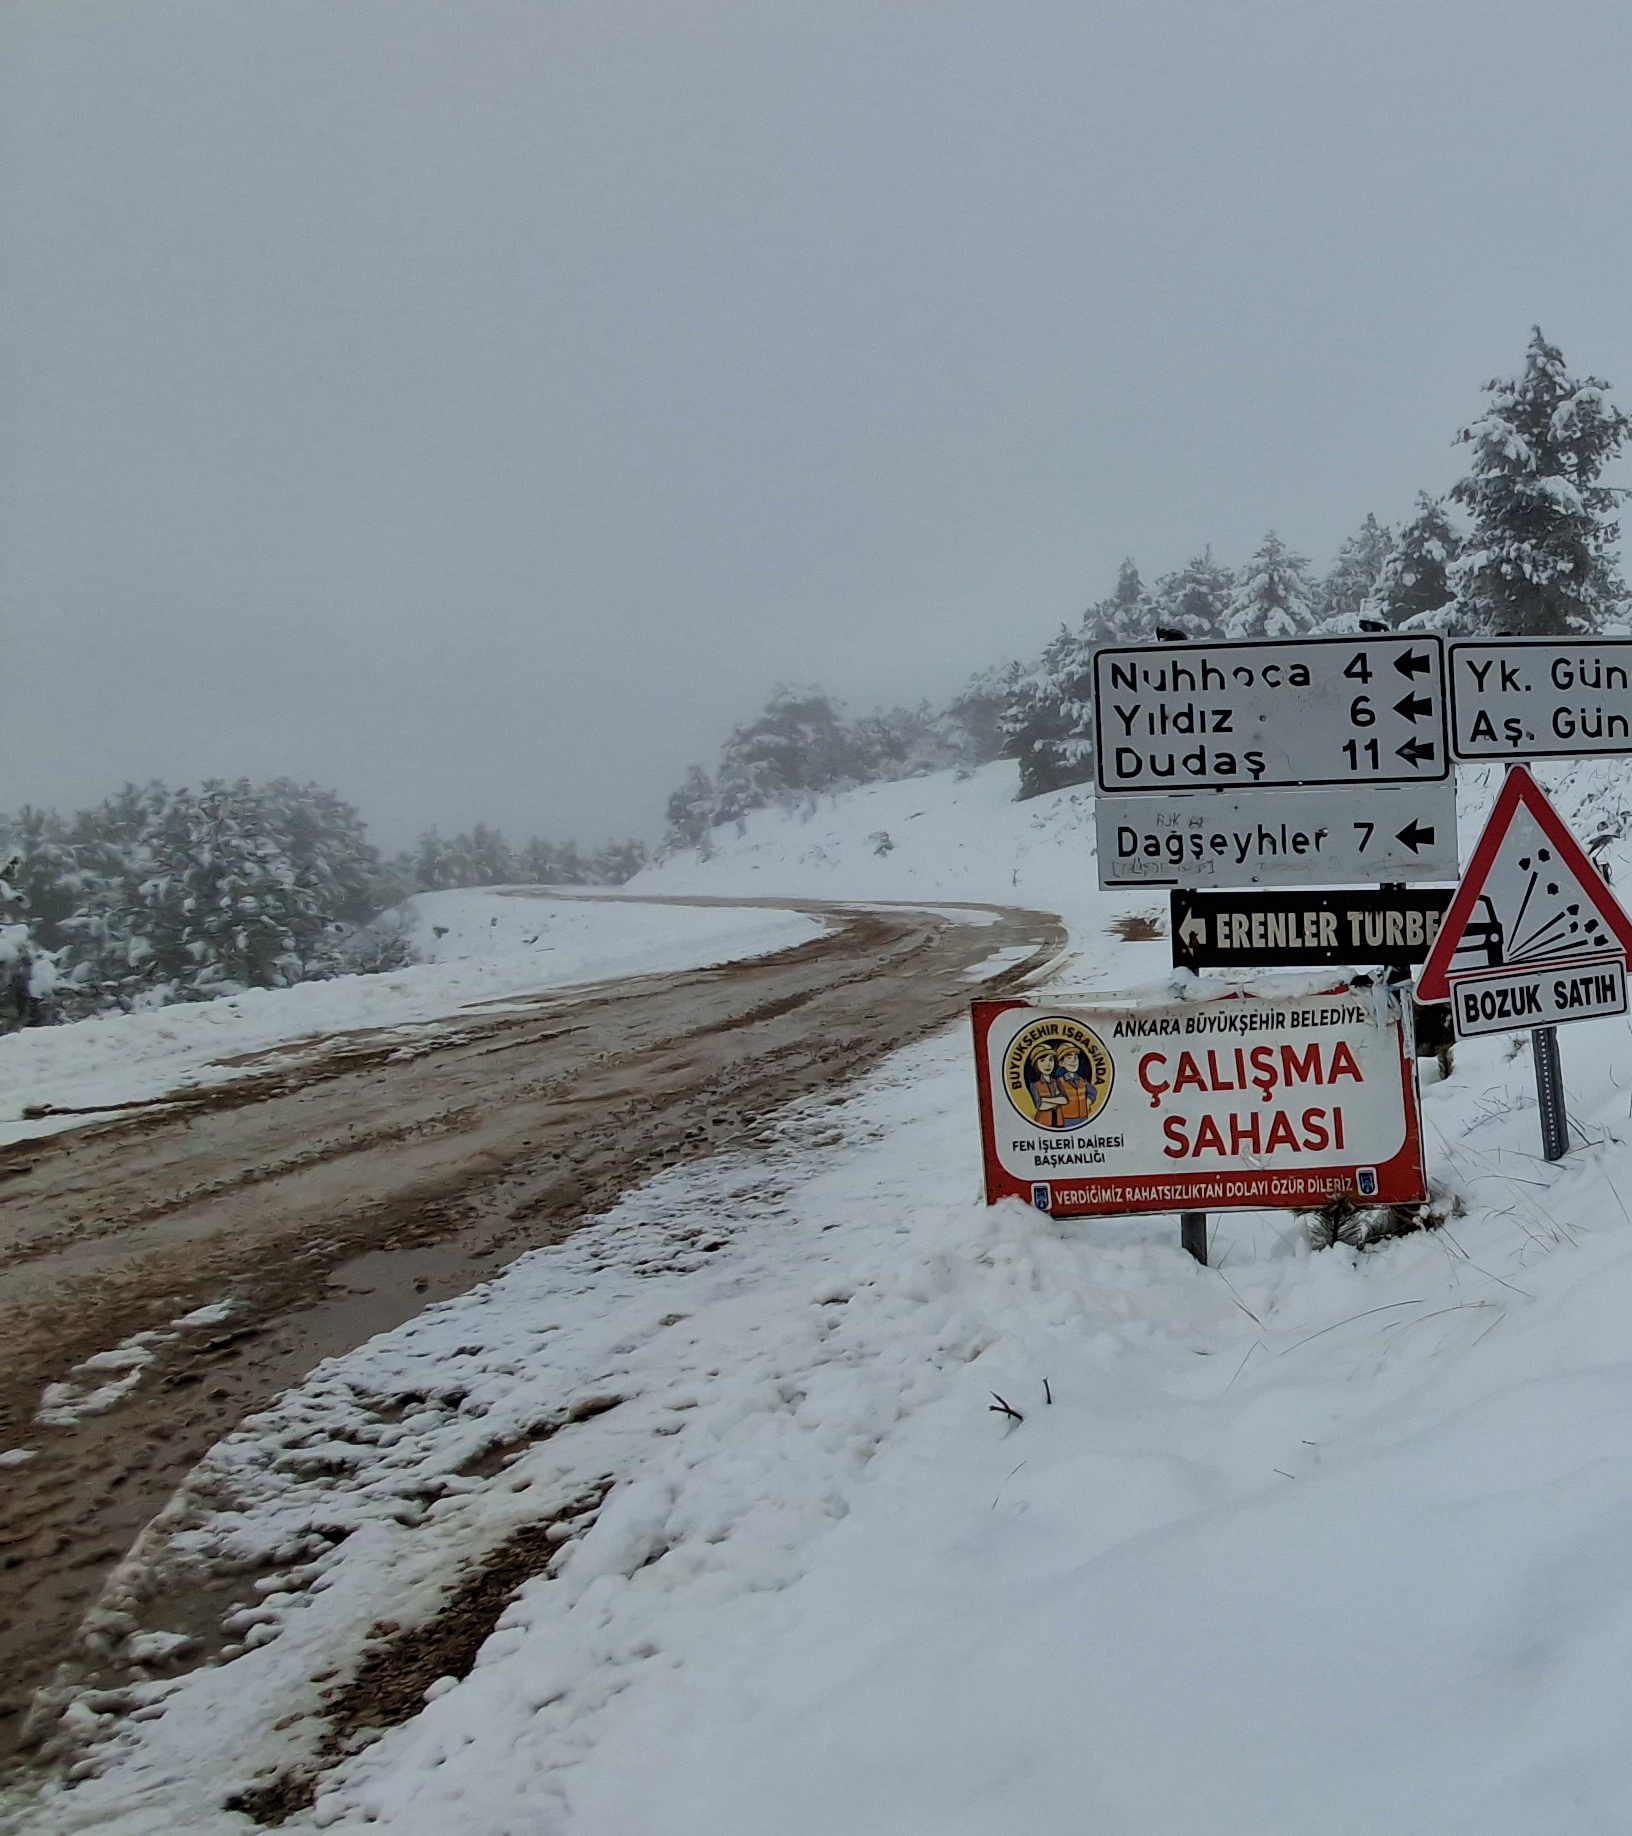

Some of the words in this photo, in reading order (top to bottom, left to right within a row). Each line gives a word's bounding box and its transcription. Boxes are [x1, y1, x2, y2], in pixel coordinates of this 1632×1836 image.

[1111, 659, 1311, 693] Nuhhoca
[1344, 653, 1373, 684] 4
[1466, 660, 1532, 693] Yk.
[1113, 703, 1234, 736] Yıldız
[1350, 696, 1376, 727] 6
[1470, 710, 1535, 747] Aş.
[1115, 745, 1266, 781] Dudaş
[1342, 738, 1380, 770] 11
[1117, 824, 1327, 864] Dağşeyhler
[1353, 822, 1375, 853] 7
[1216, 912, 1339, 949] ERENLER
[1464, 984, 1543, 1024] BOZUK
[1553, 973, 1617, 1009] SATIH
[1113, 1016, 1181, 1038] ANKARA
[1184, 1009, 1286, 1034] BÜYÜKŞEHİR
[1138, 1040, 1363, 1108] ÇALIŞMA
[1012, 1140, 1035, 1152] FEN
[1038, 1136, 1074, 1153] İŞLERİ
[1077, 1133, 1124, 1149] DAİRESİ
[1163, 1106, 1346, 1159] SAHASI
[1034, 1150, 1106, 1168] BAŞKANLIĞI
[1055, 1184, 1123, 1204] VERDİĞİMİZ
[1126, 1182, 1223, 1201] RAHATSIZLIKTAN
[1226, 1180, 1268, 1196] DOLAYI
[1271, 1175, 1305, 1195] ÖZÜR
[1307, 1176, 1353, 1193] DİLERİZ
